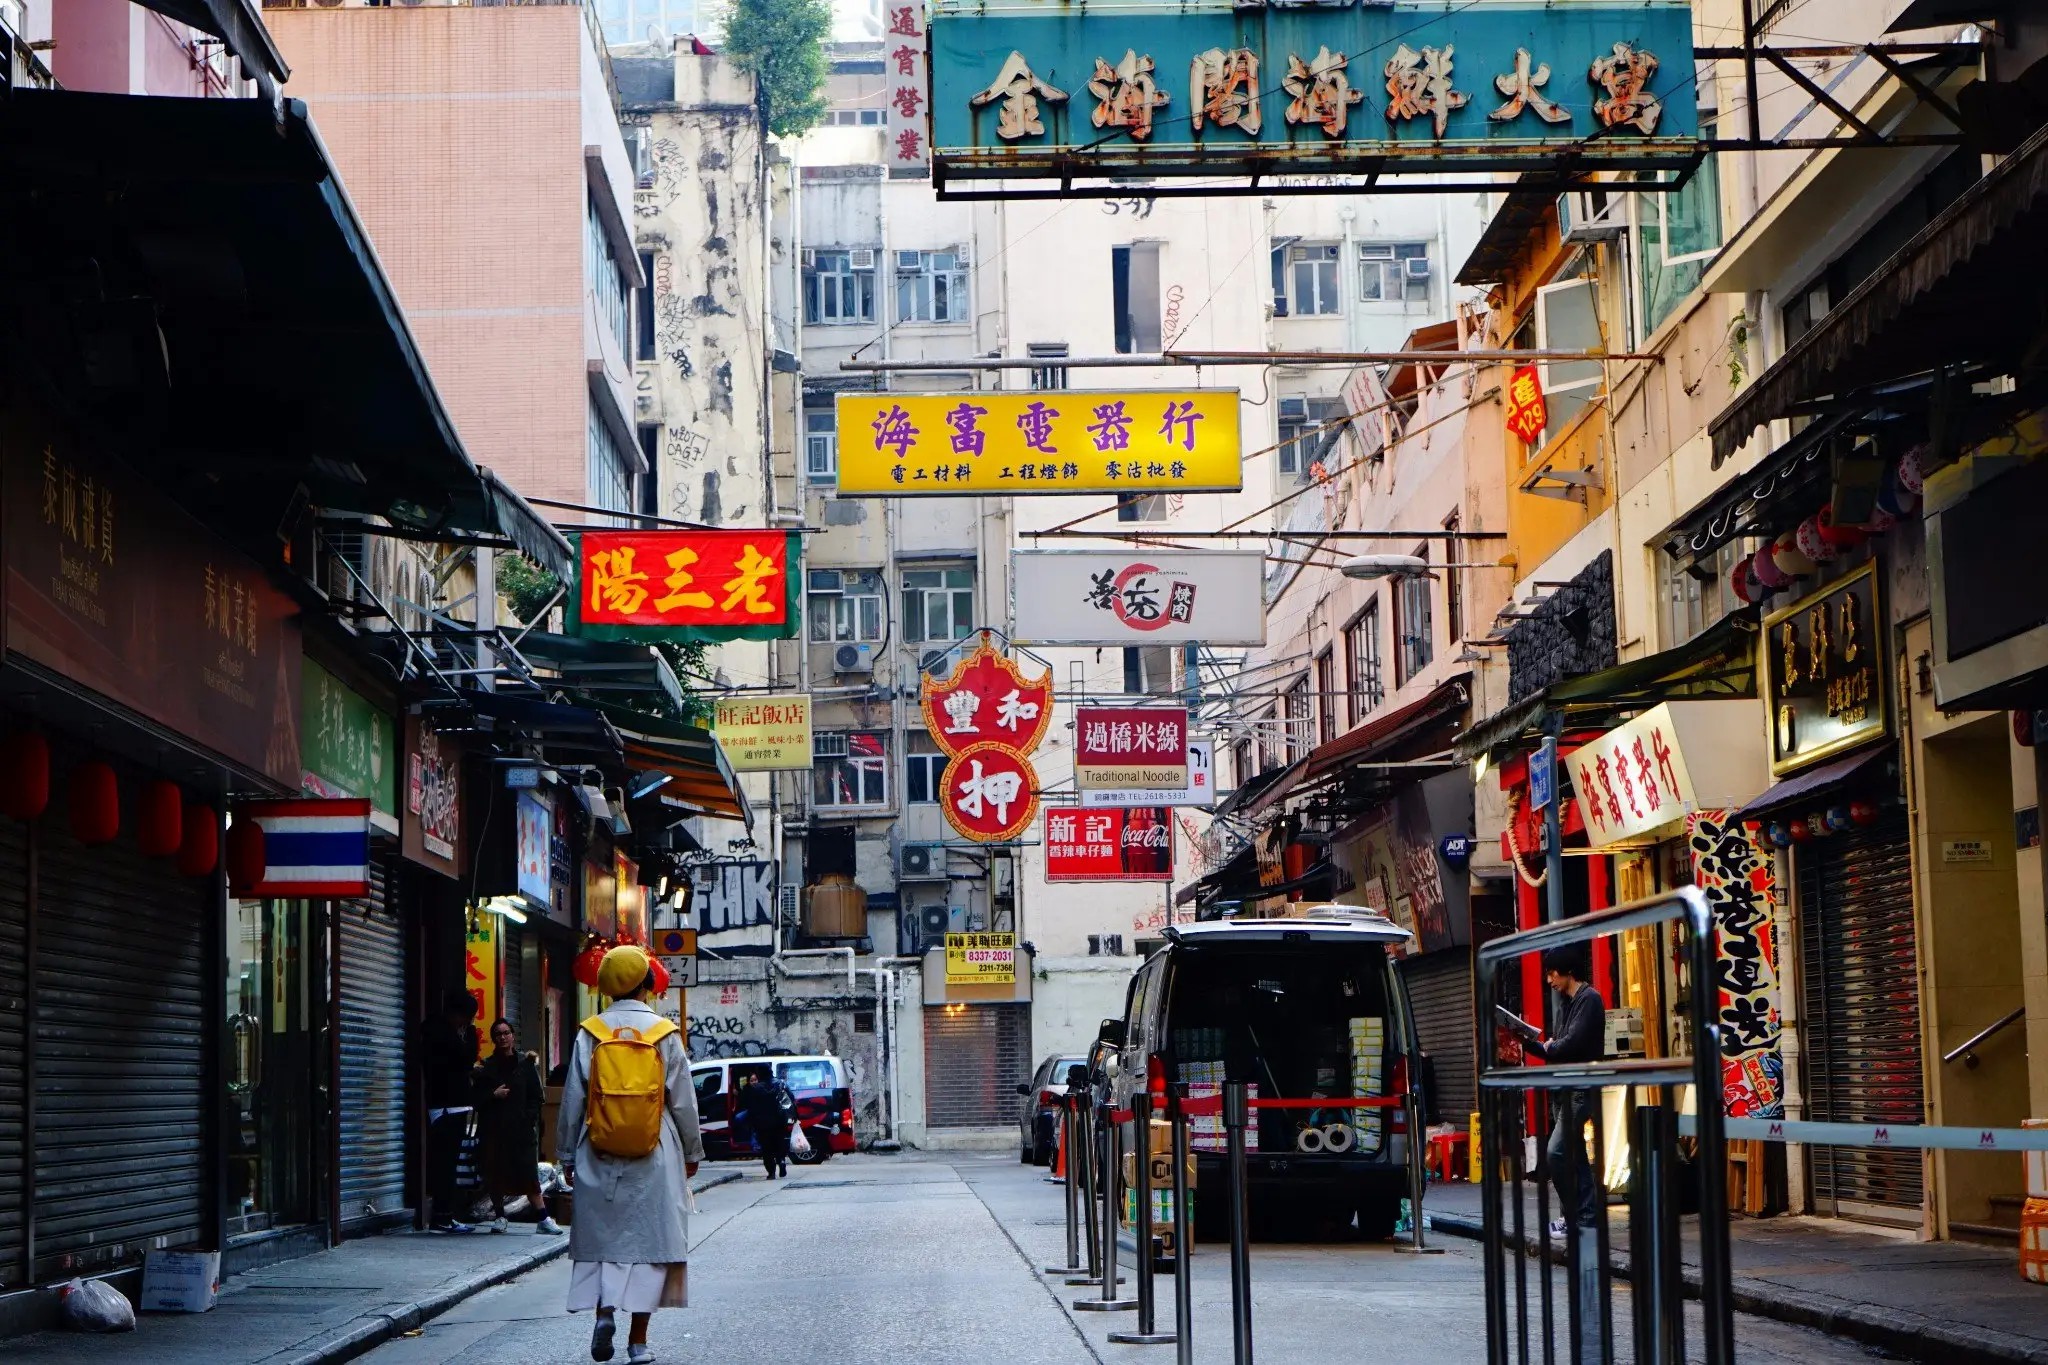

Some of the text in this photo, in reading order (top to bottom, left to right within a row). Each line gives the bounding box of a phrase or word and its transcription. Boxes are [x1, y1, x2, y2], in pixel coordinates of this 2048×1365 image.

[889, 7, 924, 162] 通宵營業
[871, 400, 1205, 458] 海富電器行
[891, 463, 972, 483] 電工材料
[999, 462, 1079, 480] 工程燈飾
[1084, 721, 1179, 753] 過橋米線
[1084, 770, 1180, 782] Traditional Noodle
[957, 760, 1023, 825] 押
[1049, 815, 1113, 843] 新記
[1446, 840, 1465, 851] ADT
